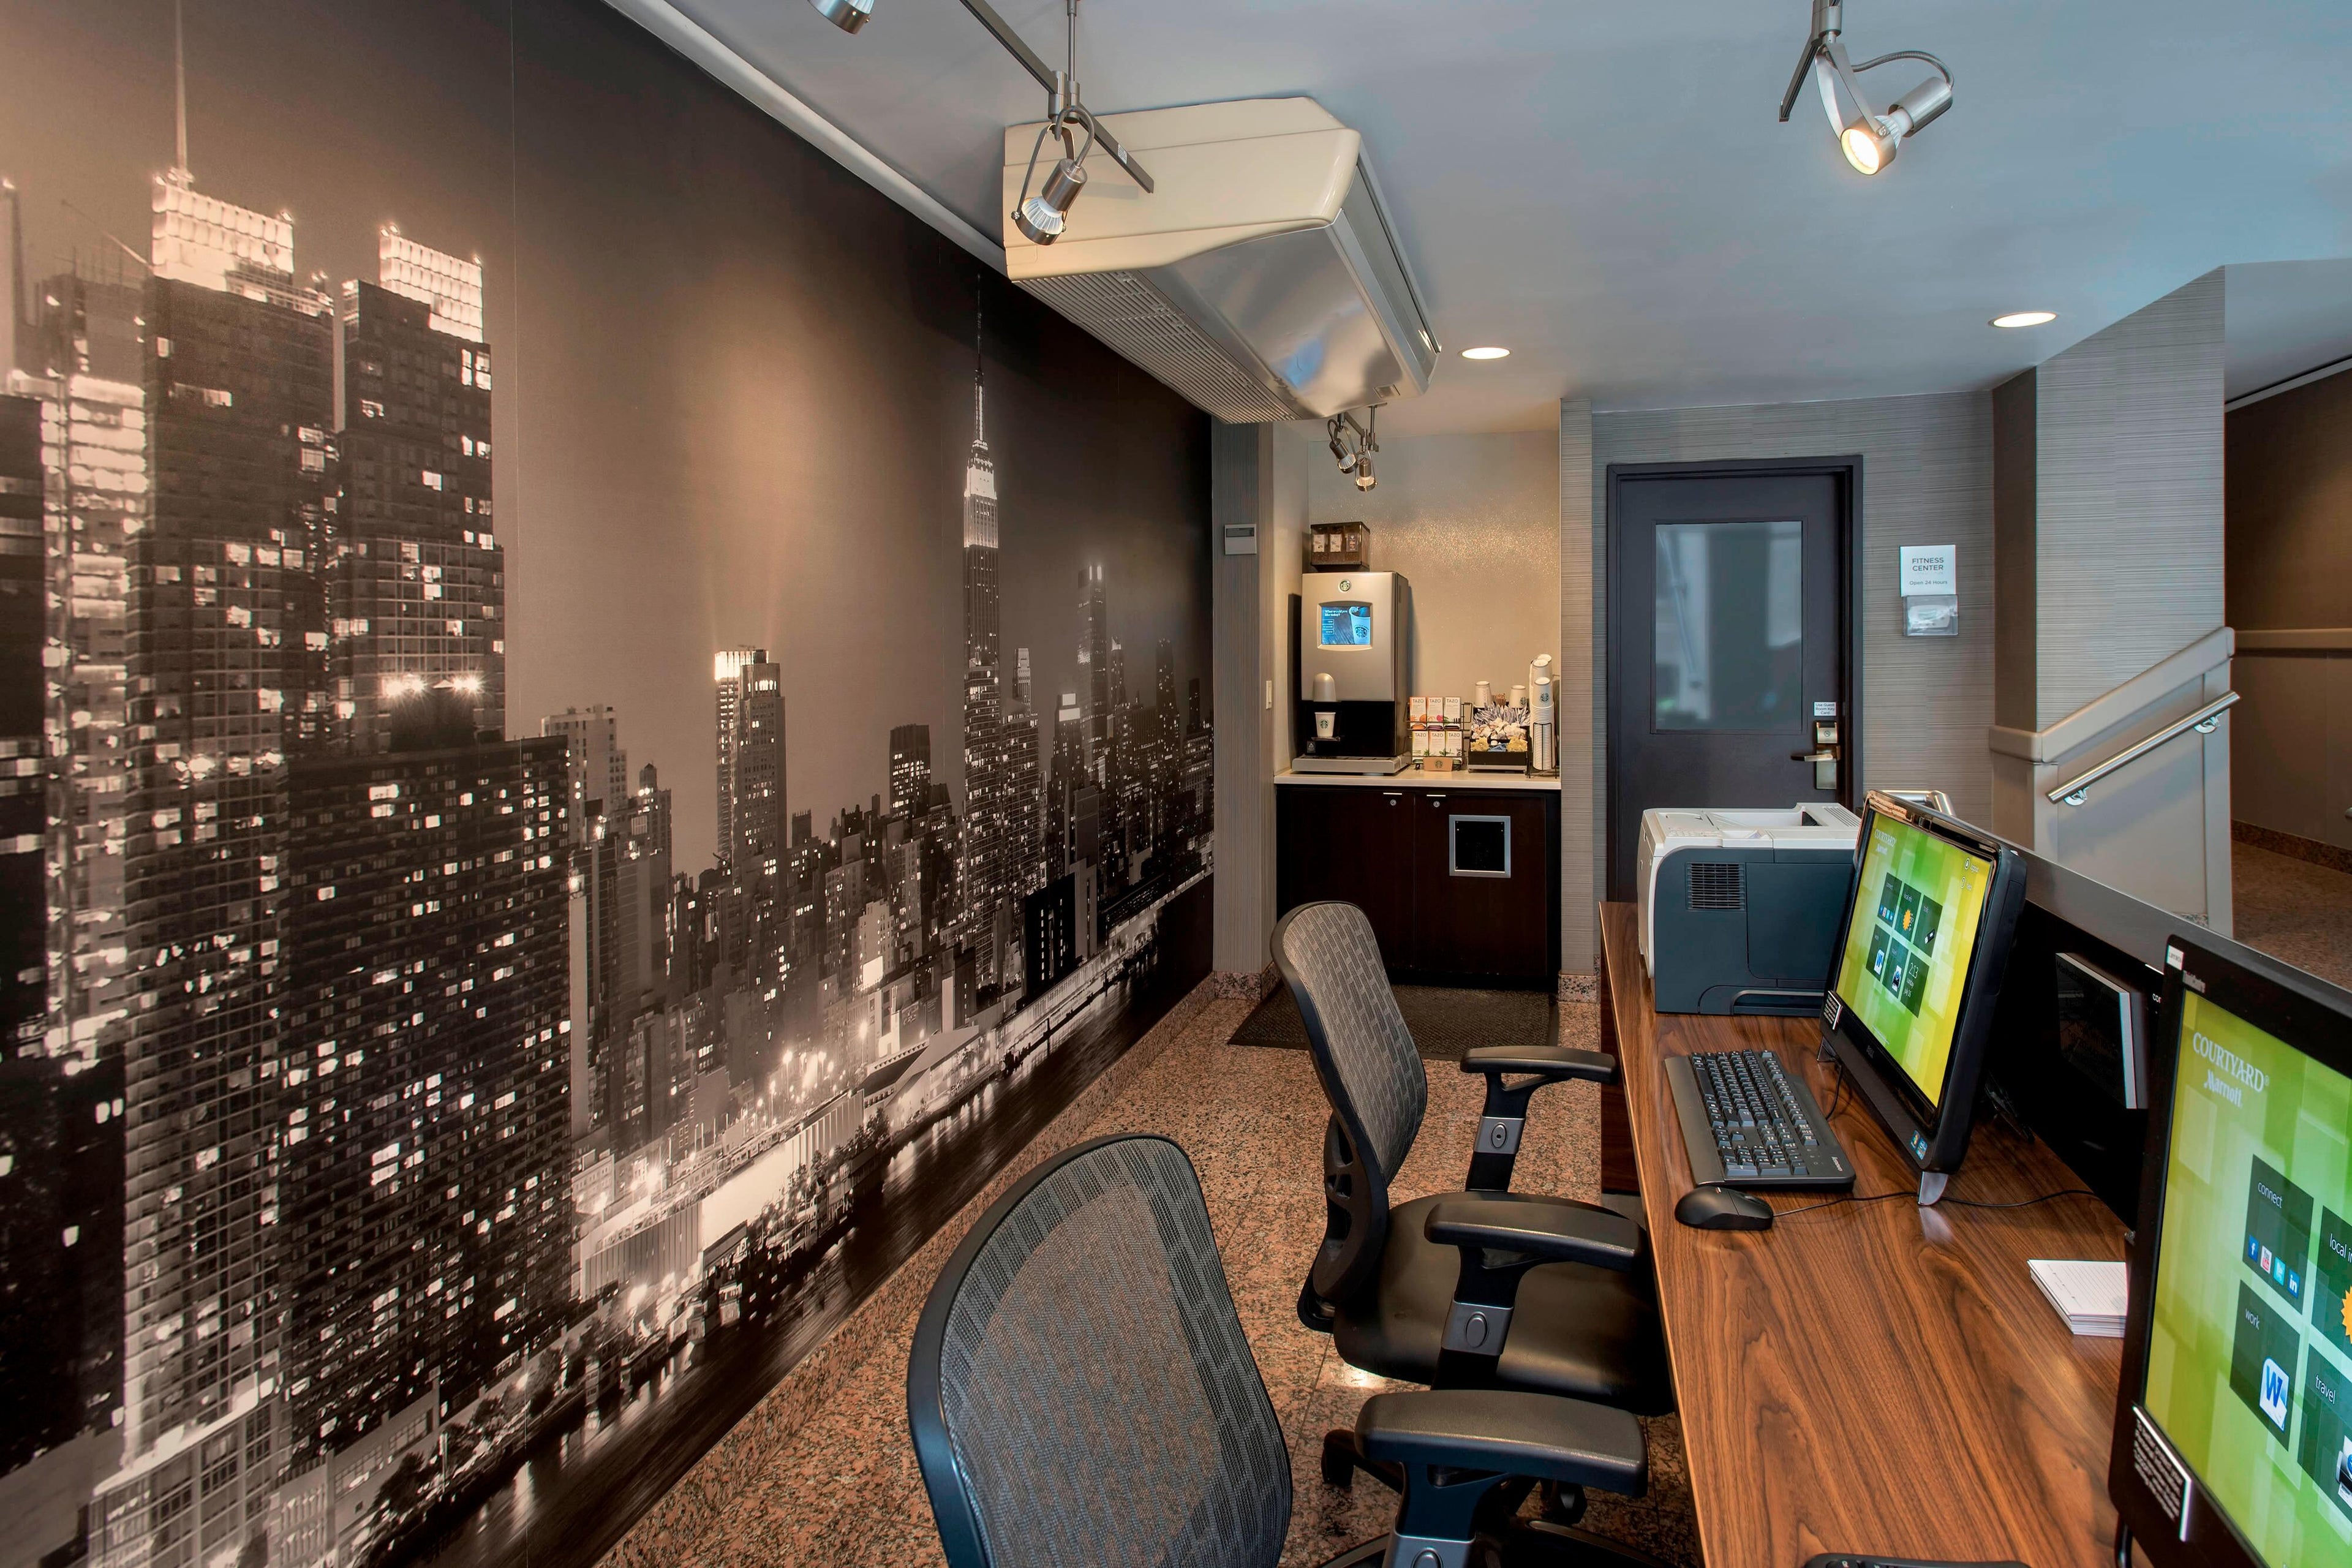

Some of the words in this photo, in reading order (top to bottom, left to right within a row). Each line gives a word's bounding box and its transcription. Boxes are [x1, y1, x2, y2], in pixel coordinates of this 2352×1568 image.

[2193, 1032, 2264, 1093] COURTYARD
[2258, 1182, 2283, 1208] connect
[2329, 1233, 2347, 1258] local
[2245, 1308, 2260, 1330] work
[2316, 1375, 2335, 1404] travel
